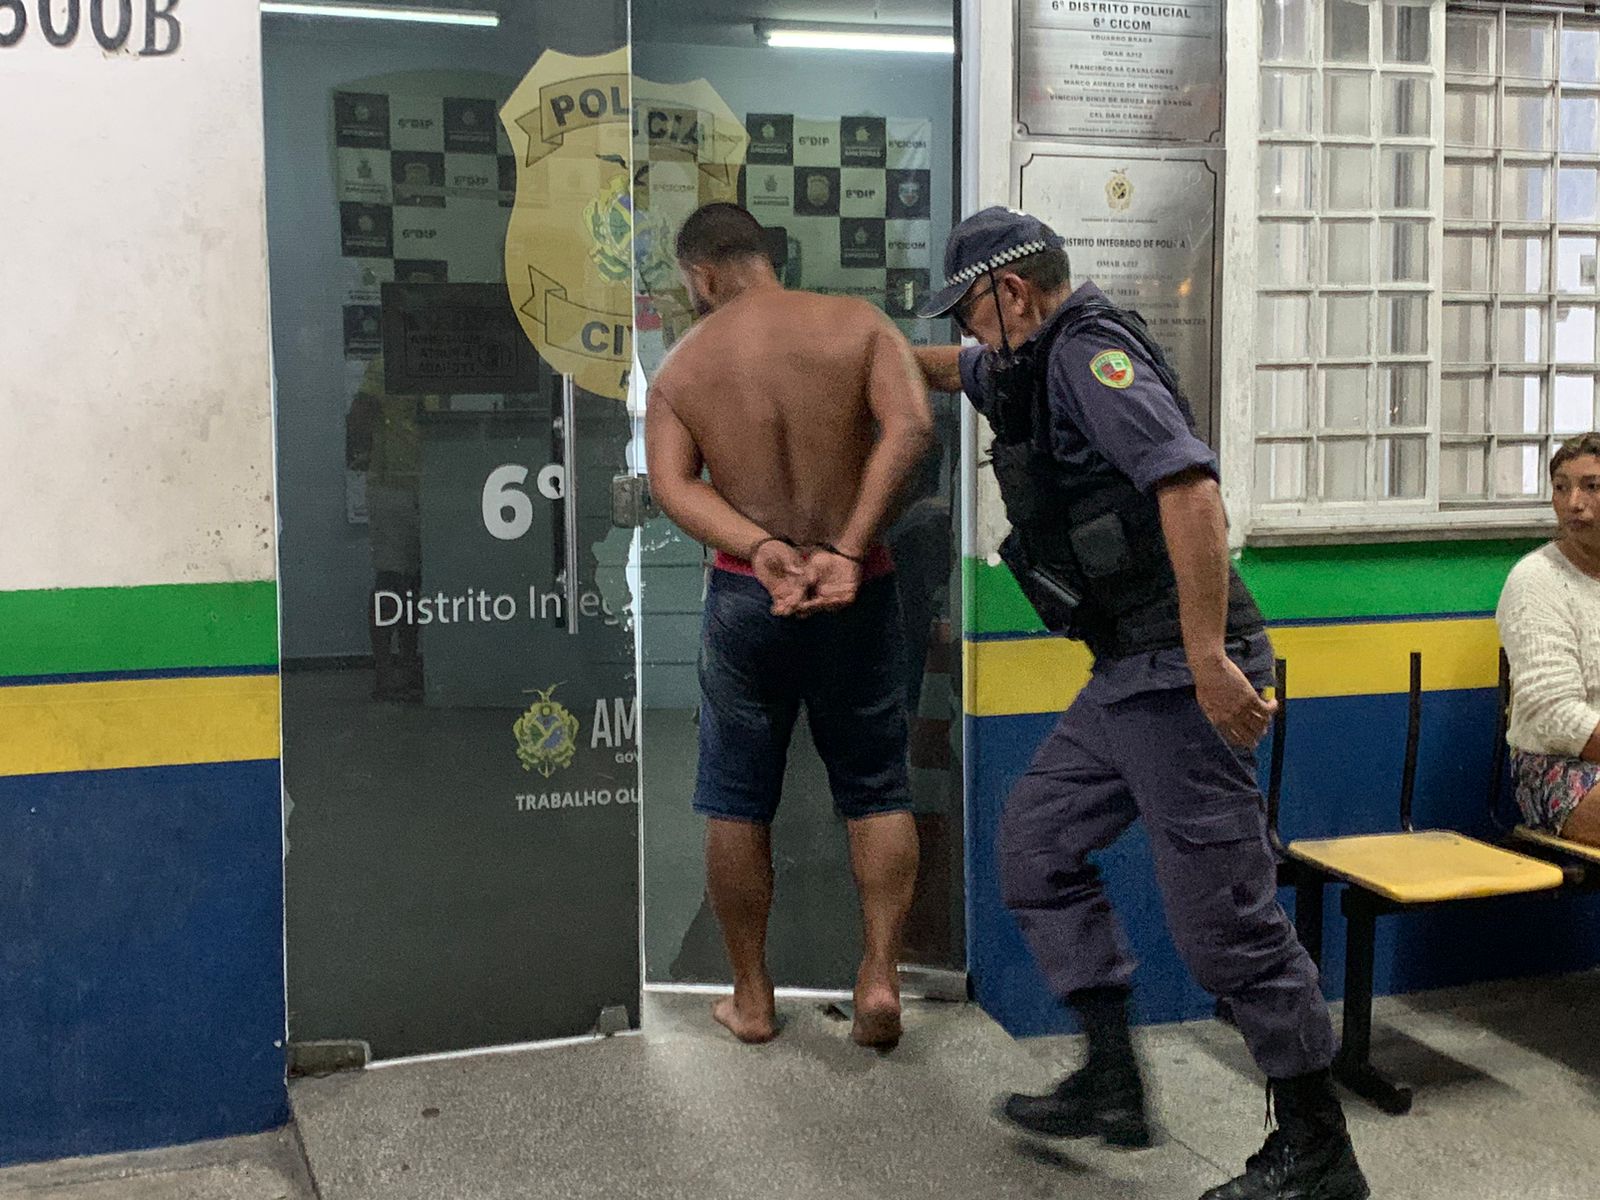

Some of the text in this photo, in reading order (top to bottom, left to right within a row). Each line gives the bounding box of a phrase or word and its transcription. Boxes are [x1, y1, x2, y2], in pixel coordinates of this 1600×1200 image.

[1069, 1, 1129, 15] DISTRITO
[1133, 5, 1192, 18] POLICIAL
[1110, 19, 1152, 31] CICOM
[1070, 64, 1113, 72] FRANCISCO
[1064, 79, 1091, 87] MARCO
[1096, 238, 1141, 249] INTEGRADO
[1143, 239, 1154, 249] DE
[1096, 260, 1120, 268] OMAR
[374, 587, 517, 626] Distrito
[515, 788, 612, 811] TRABALHO
